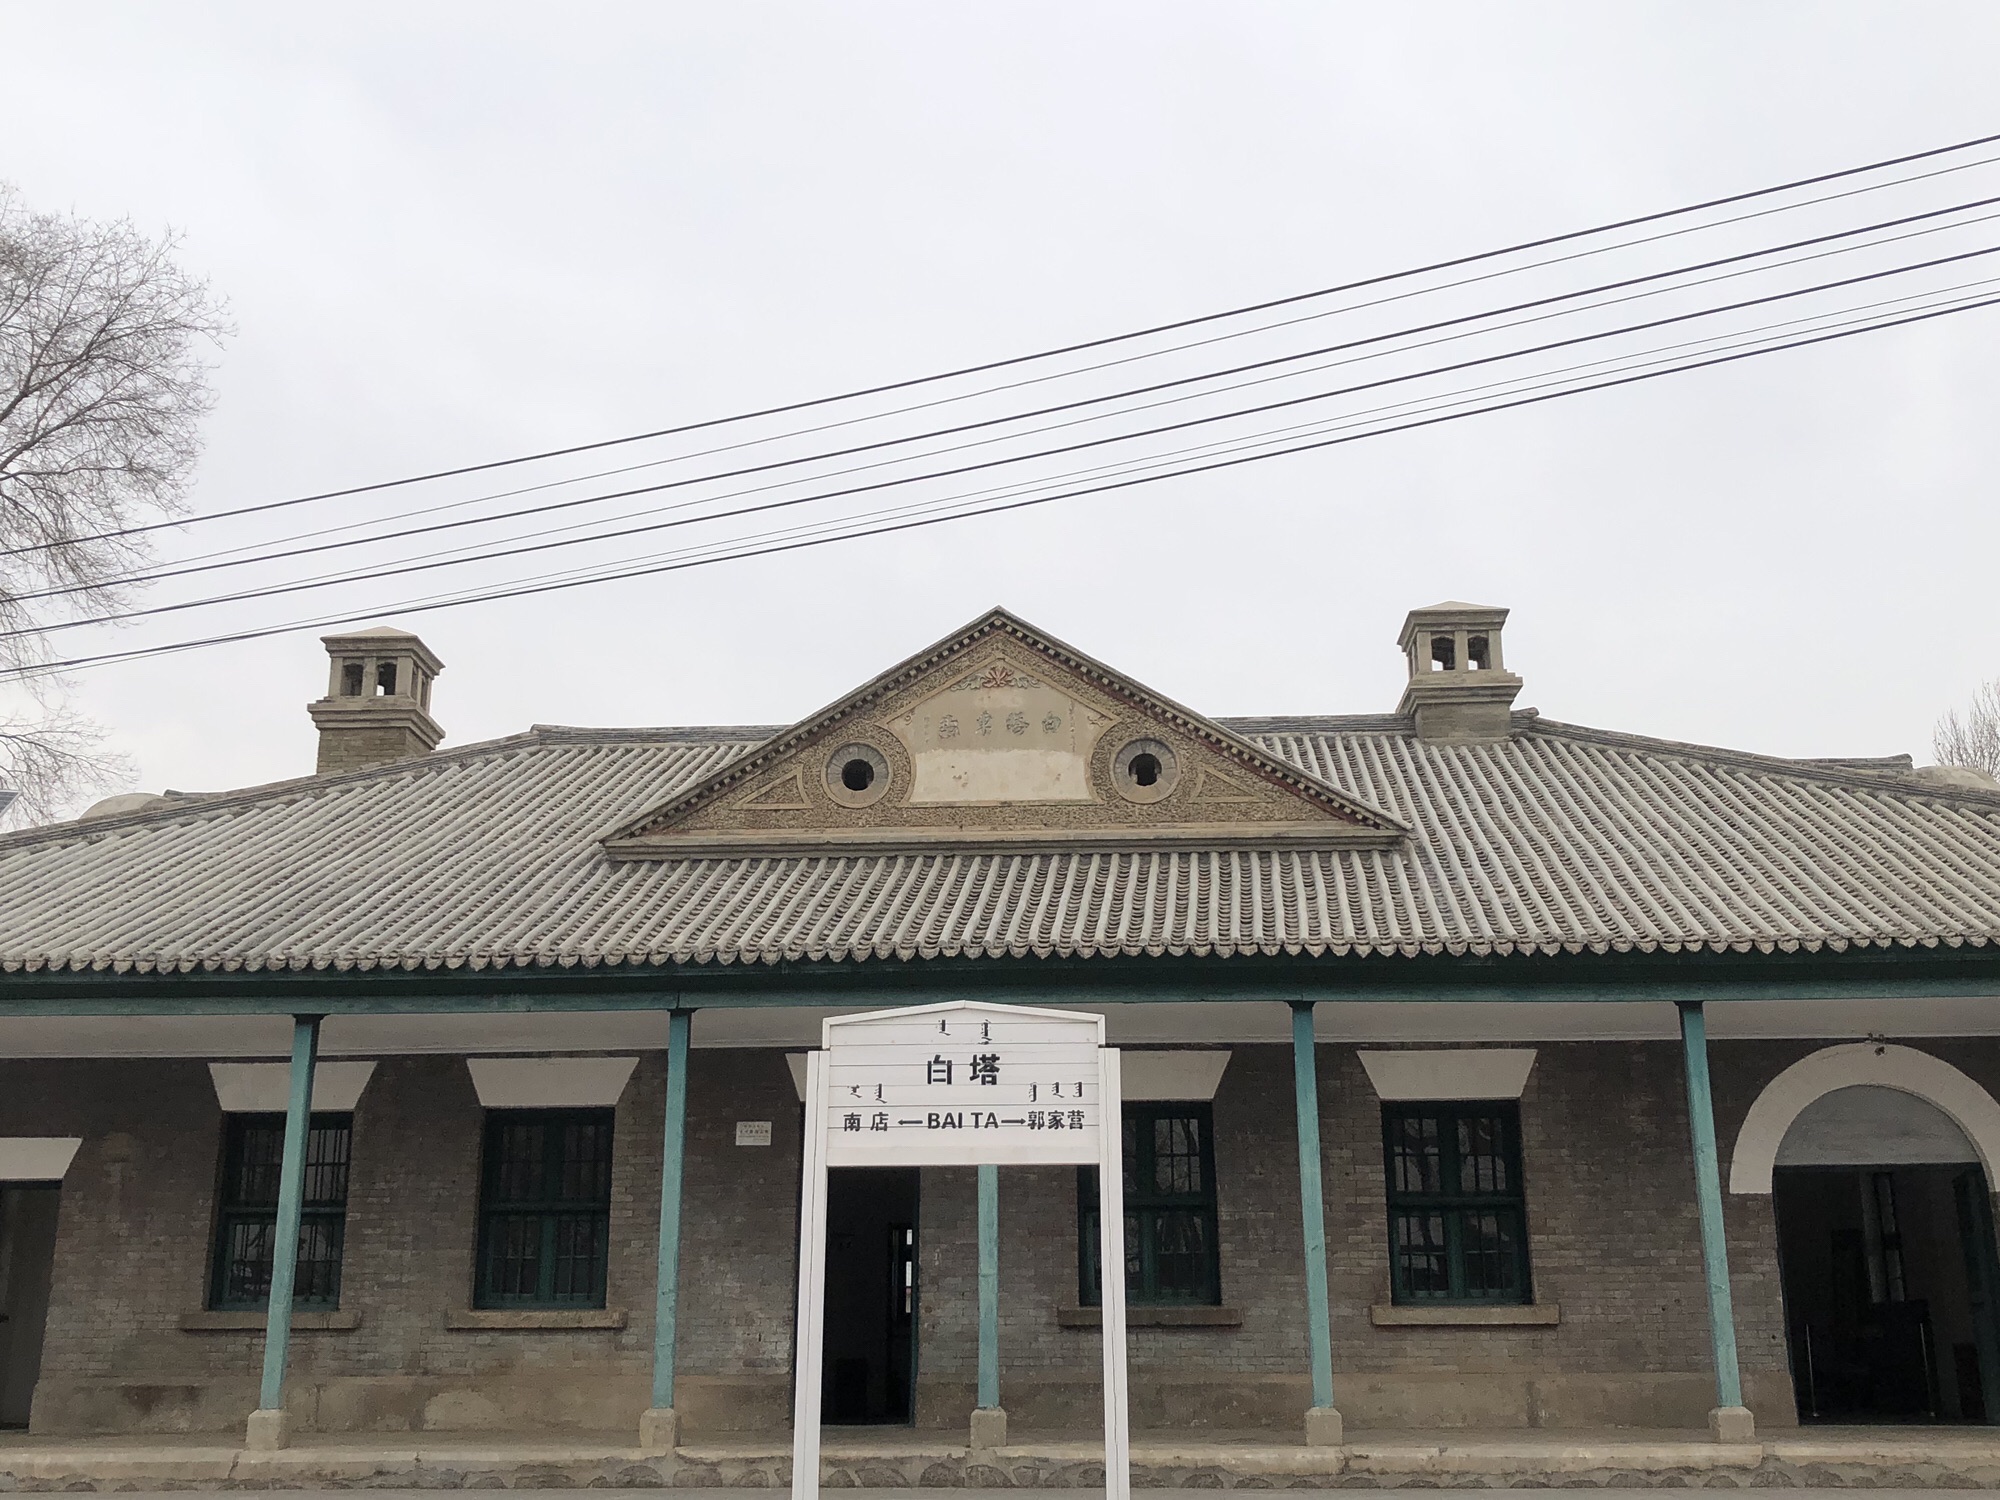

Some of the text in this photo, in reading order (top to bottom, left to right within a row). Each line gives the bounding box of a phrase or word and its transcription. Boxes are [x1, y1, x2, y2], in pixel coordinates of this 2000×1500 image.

[927, 1054, 1000, 1085] 白塔
[843, 1112, 889, 1131] 南店
[927, 1112, 999, 1129] BAI TA
[1027, 1110, 1085, 1130] 郭家营
